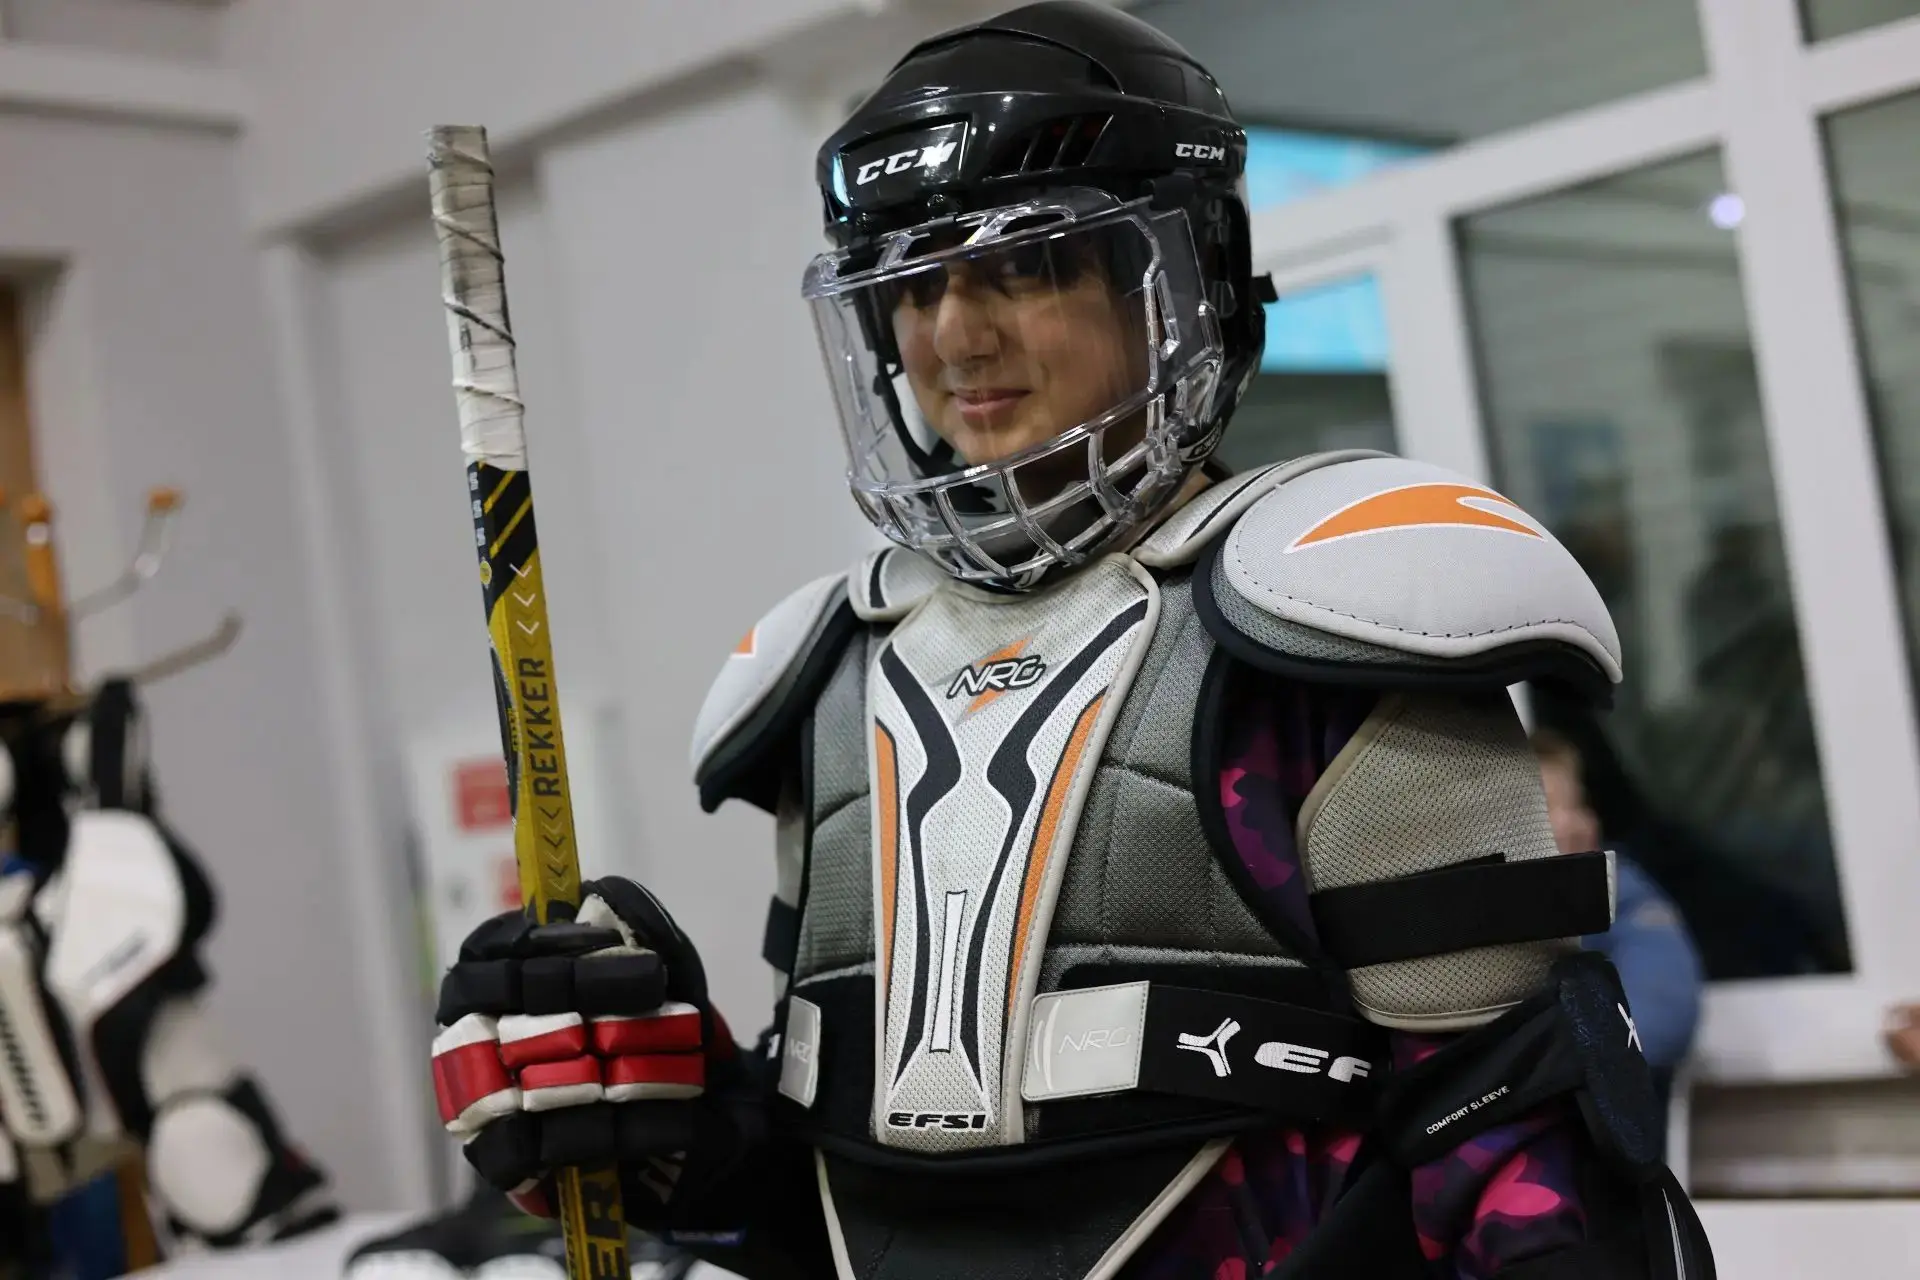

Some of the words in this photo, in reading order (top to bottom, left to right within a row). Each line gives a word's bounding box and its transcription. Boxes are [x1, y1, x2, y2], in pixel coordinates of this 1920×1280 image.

[856, 139, 957, 187] CCM
[1175, 143, 1225, 161] CCM
[518, 657, 562, 797] REKKER
[888, 1112, 986, 1129] EFSI
[1426, 1106, 1469, 1135] COMFORT
[1470, 1085, 1510, 1110] SLEEVE
